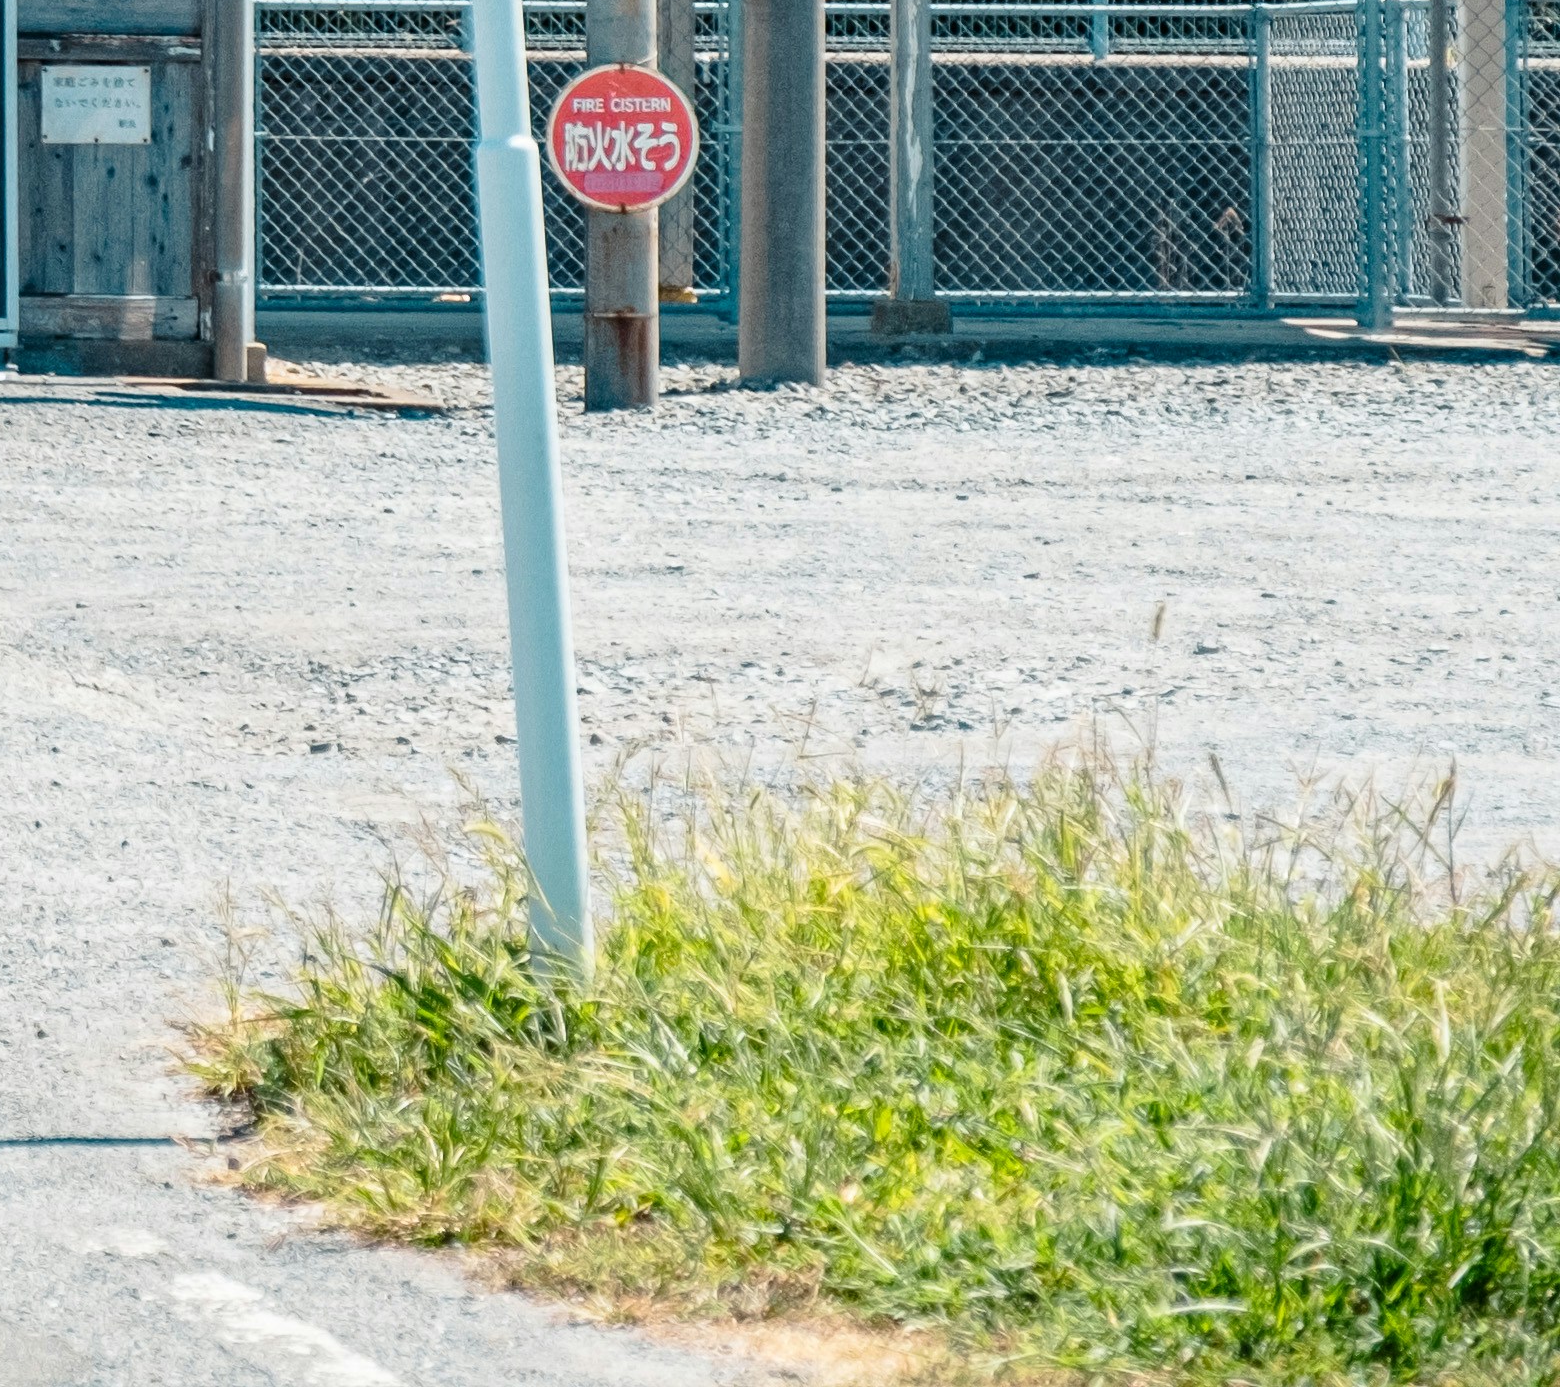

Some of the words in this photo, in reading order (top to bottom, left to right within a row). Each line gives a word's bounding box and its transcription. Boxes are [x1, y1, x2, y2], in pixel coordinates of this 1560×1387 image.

[573, 98, 605, 114] FIRE
[610, 97, 671, 113] CISTERN
[564, 120, 681, 172] 防火水そう
